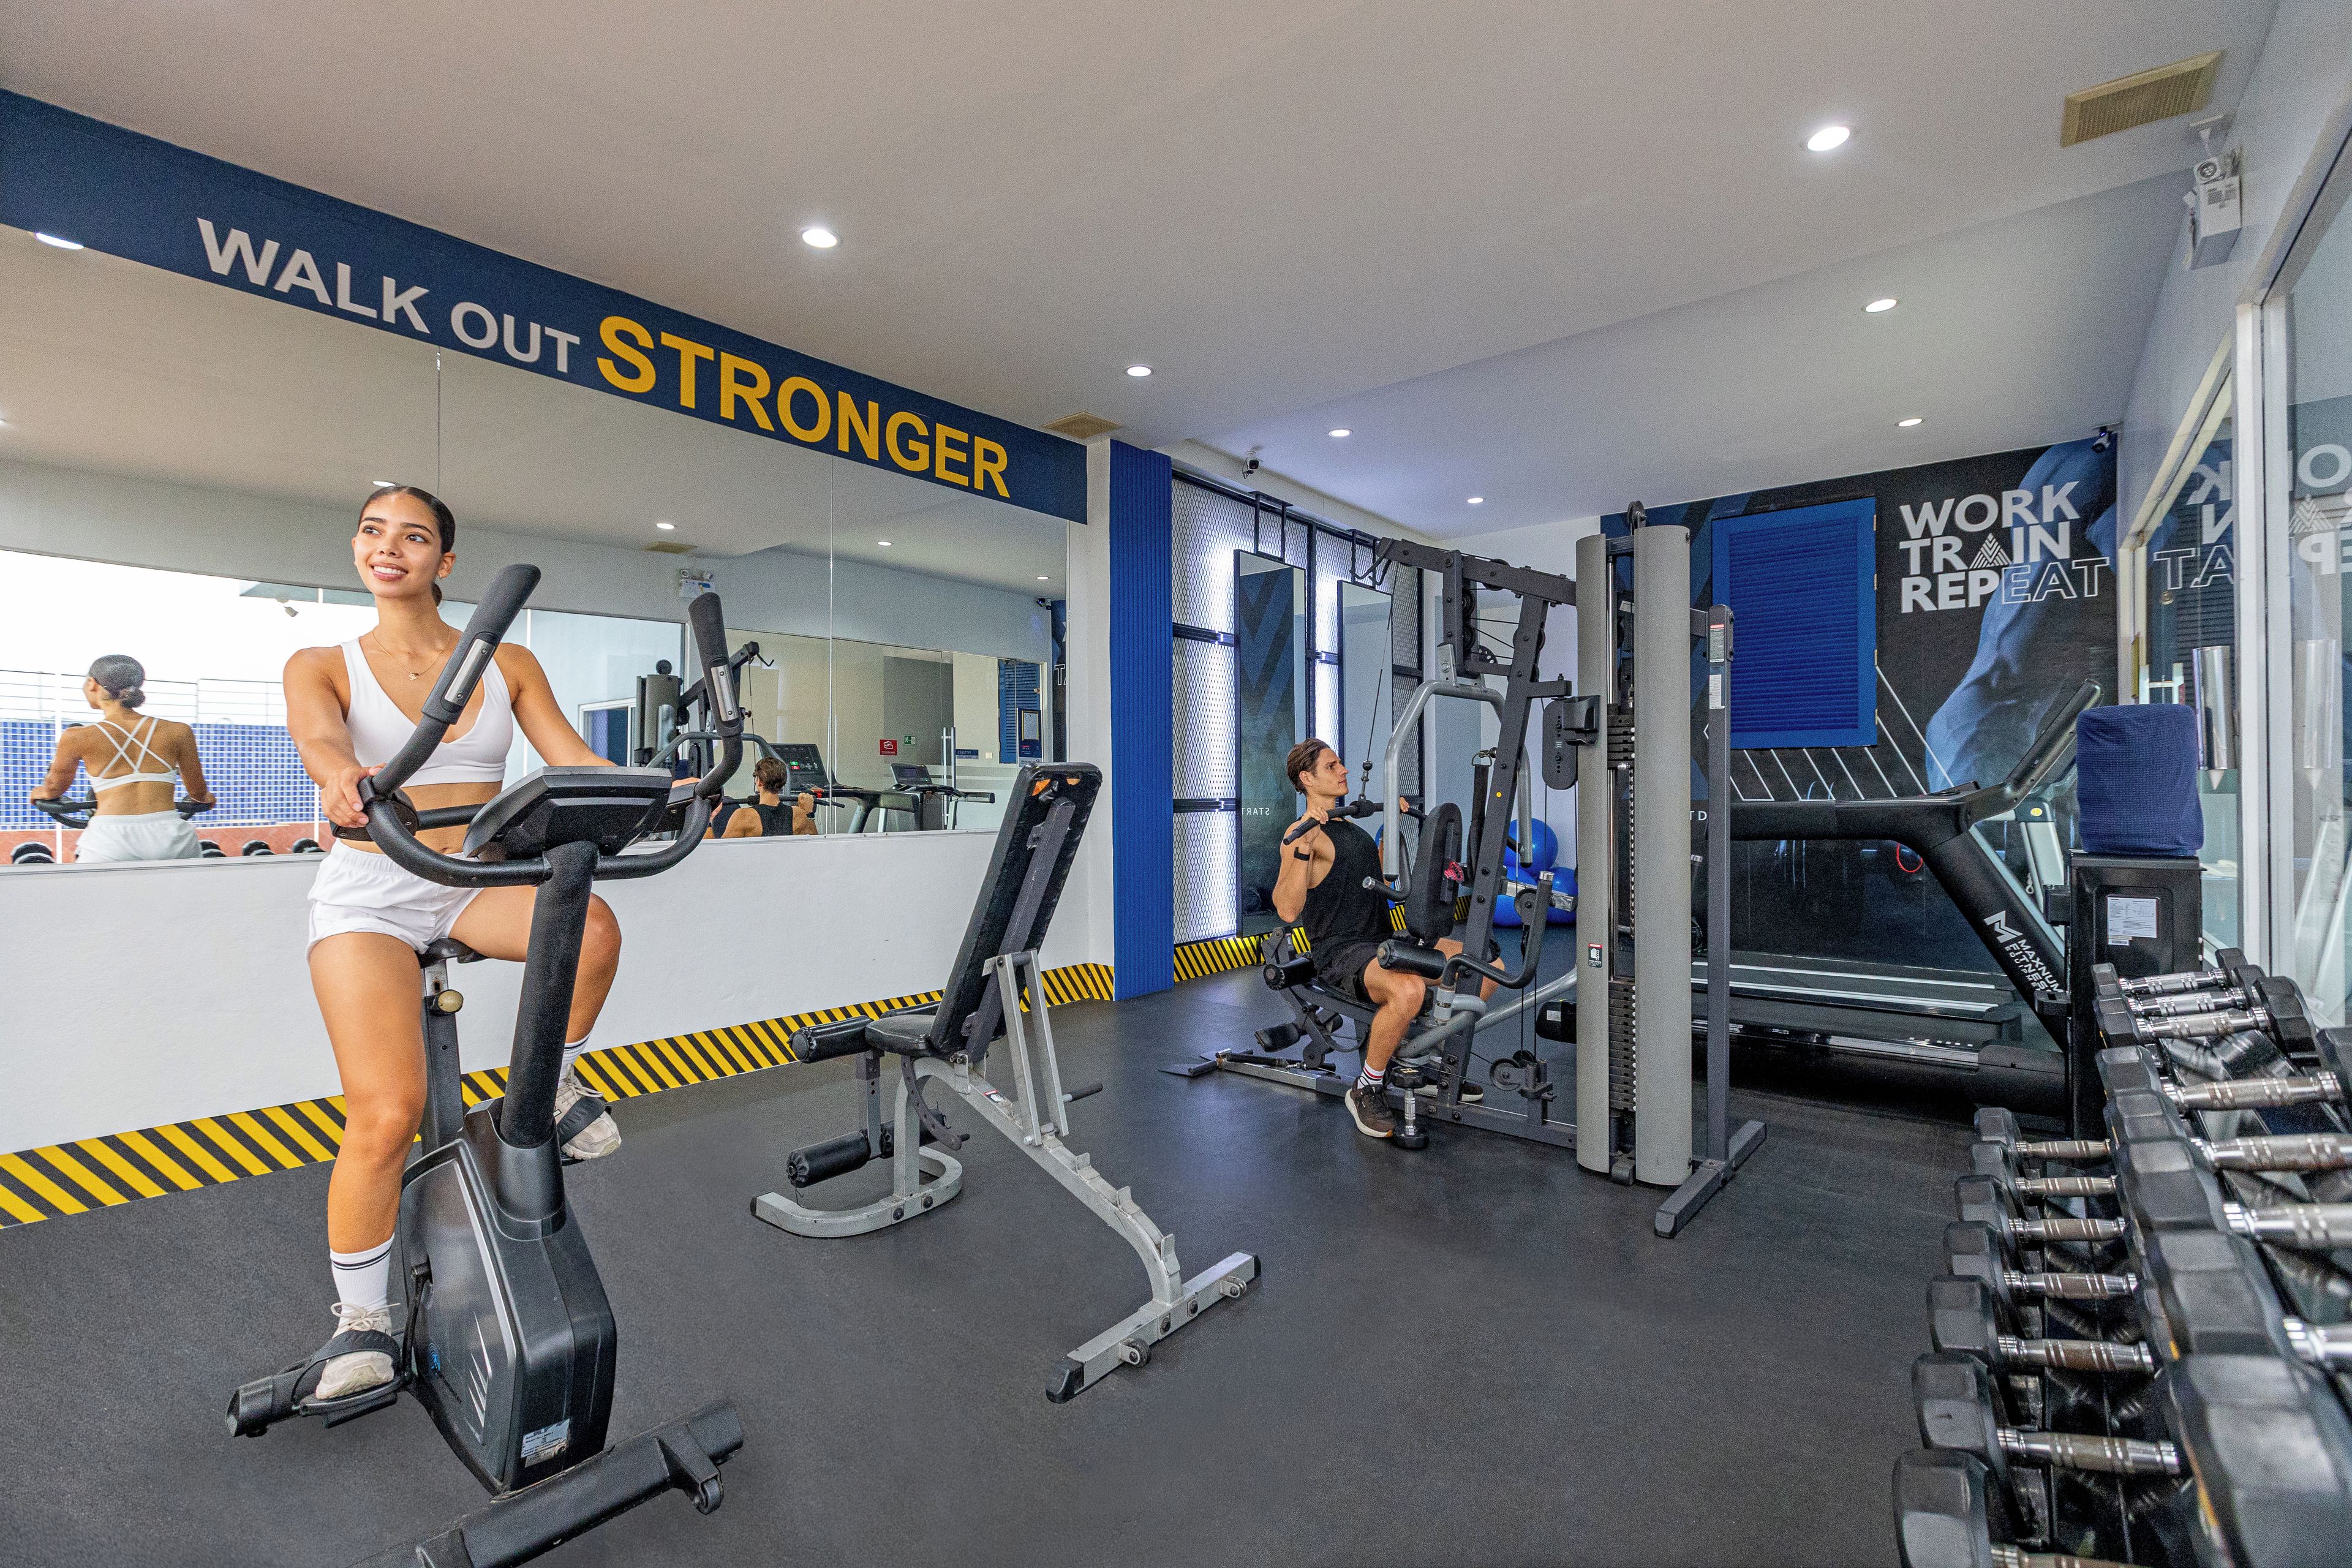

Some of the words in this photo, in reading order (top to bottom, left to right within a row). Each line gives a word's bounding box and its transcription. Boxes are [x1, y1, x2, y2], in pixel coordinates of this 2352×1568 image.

[197, 217, 431, 334] WALK
[451, 301, 581, 374] OUT
[597, 315, 1011, 499] STRONGER
[1899, 481, 2080, 540] WORK
[1901, 557, 2110, 614] REPEAT
[2009, 943, 2052, 992] FITNES
[2018, 939, 2065, 993] MAXNUM
